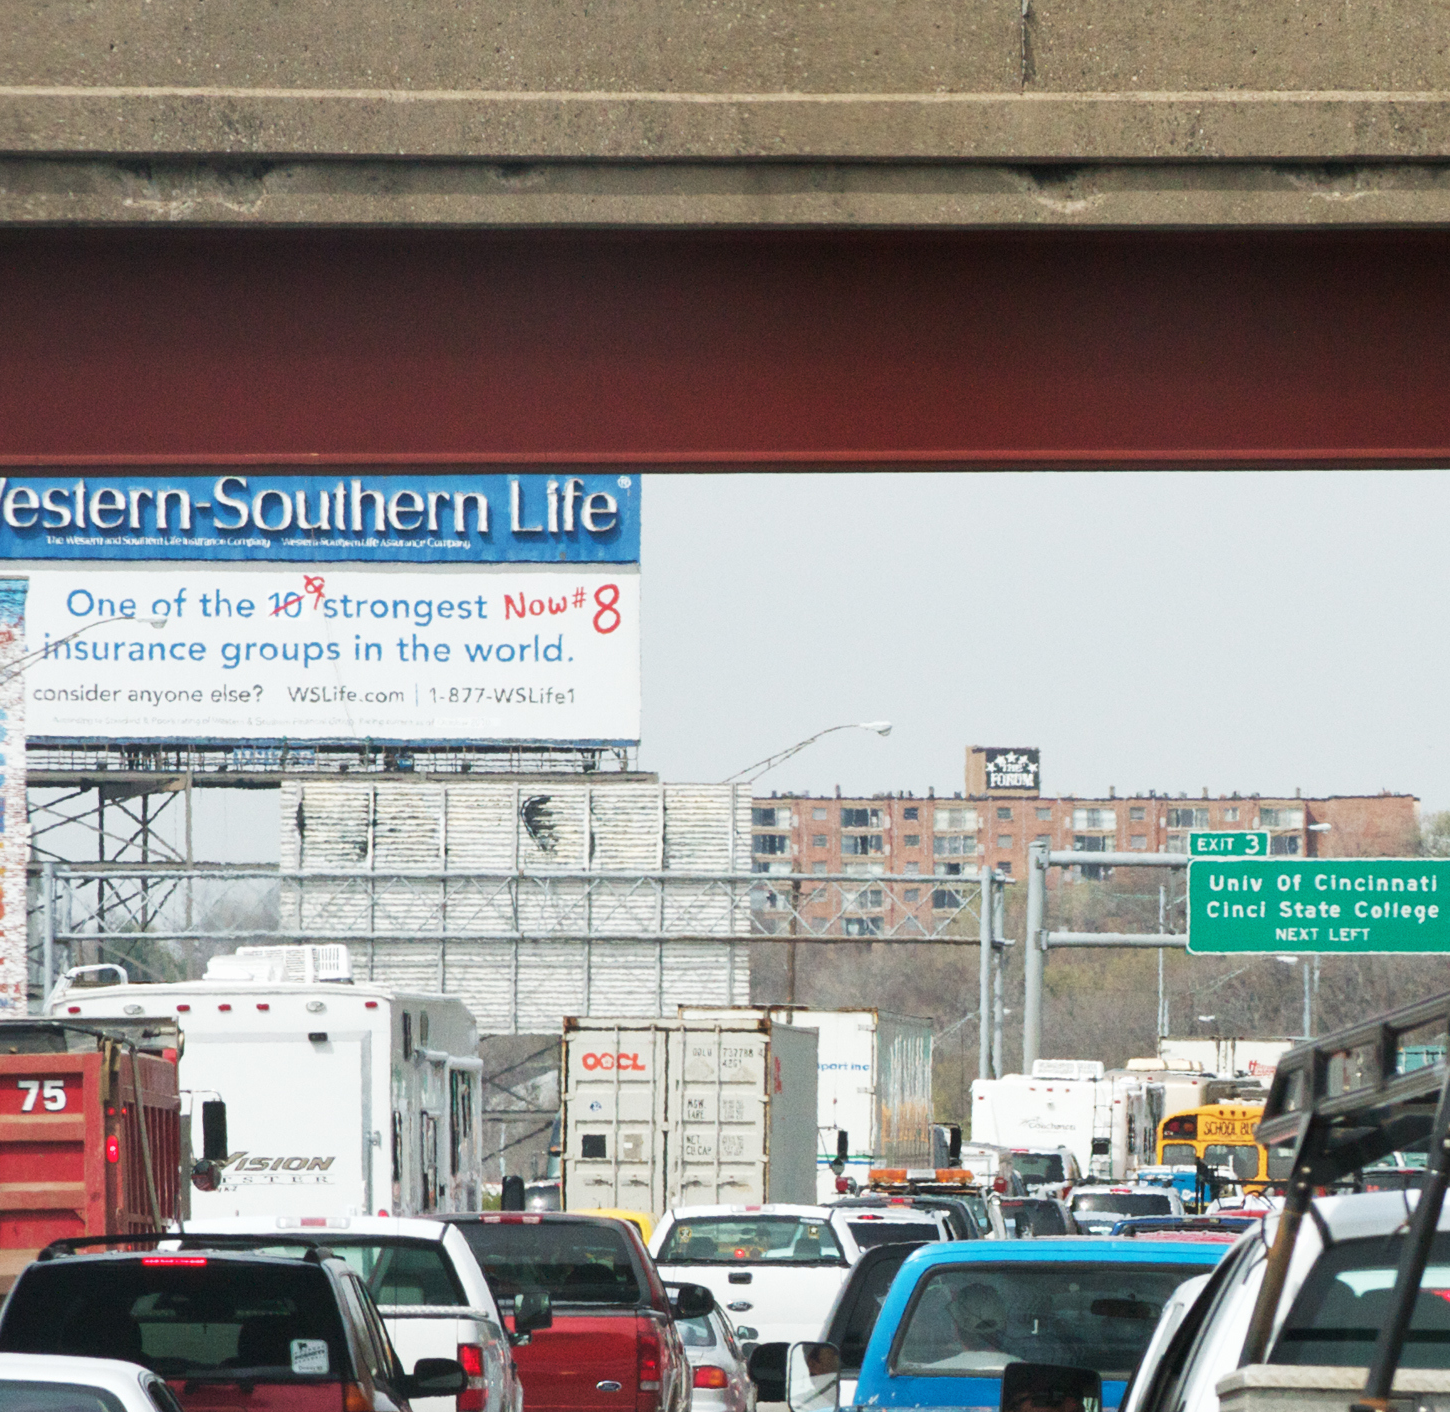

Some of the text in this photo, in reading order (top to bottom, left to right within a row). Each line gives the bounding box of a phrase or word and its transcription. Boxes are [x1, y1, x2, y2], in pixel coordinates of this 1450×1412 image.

[510, 477, 619, 533] Life
[66, 588, 136, 617] One
[151, 587, 187, 618] of
[198, 588, 256, 618] the
[323, 594, 488, 627] strongest
[503, 590, 568, 620] Now
[43, 632, 207, 662] insurance
[221, 639, 340, 670] groups
[353, 634, 383, 663] in
[399, 633, 451, 663] the
[463, 633, 575, 664] world.
[33, 683, 264, 707] consider anyone else?
[287, 685, 576, 705] WSLife.com 1-877-WSLife1
[990, 772, 1035, 787] FORUM
[1197, 835, 1260, 855] EXIT 3
[1209, 873, 1438, 892] Univ Of Cincinnati
[1206, 900, 1440, 924] Cinci State College
[1275, 928, 1370, 942] NEXT LEFT
[581, 1052, 646, 1072] OOCL
[16, 1079, 67, 1112] 75
[1203, 1121, 1254, 1136] SCHOOL BU
